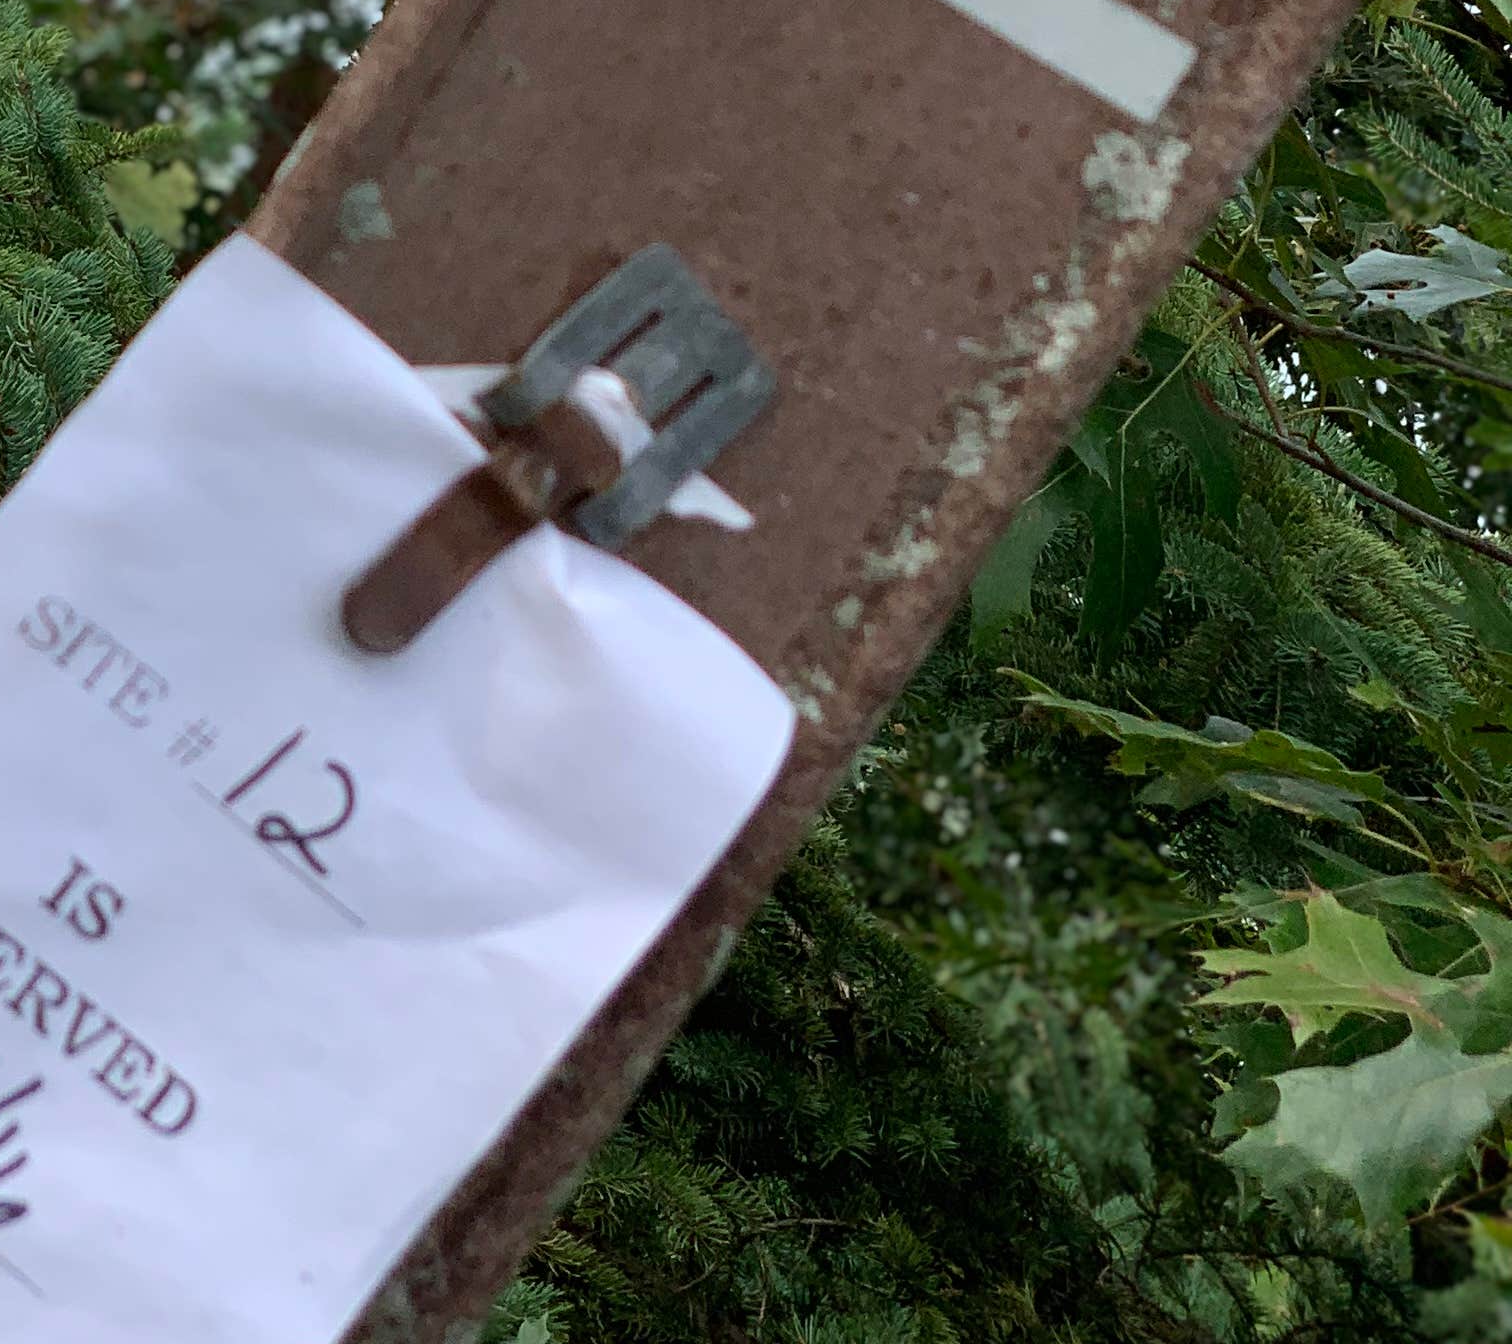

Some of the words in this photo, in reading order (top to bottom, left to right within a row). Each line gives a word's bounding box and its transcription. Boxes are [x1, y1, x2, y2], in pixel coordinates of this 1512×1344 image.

[18, 595, 170, 728] SITE
[168, 718, 219, 765] #
[221, 725, 356, 876] 12
[39, 855, 126, 942] IS
